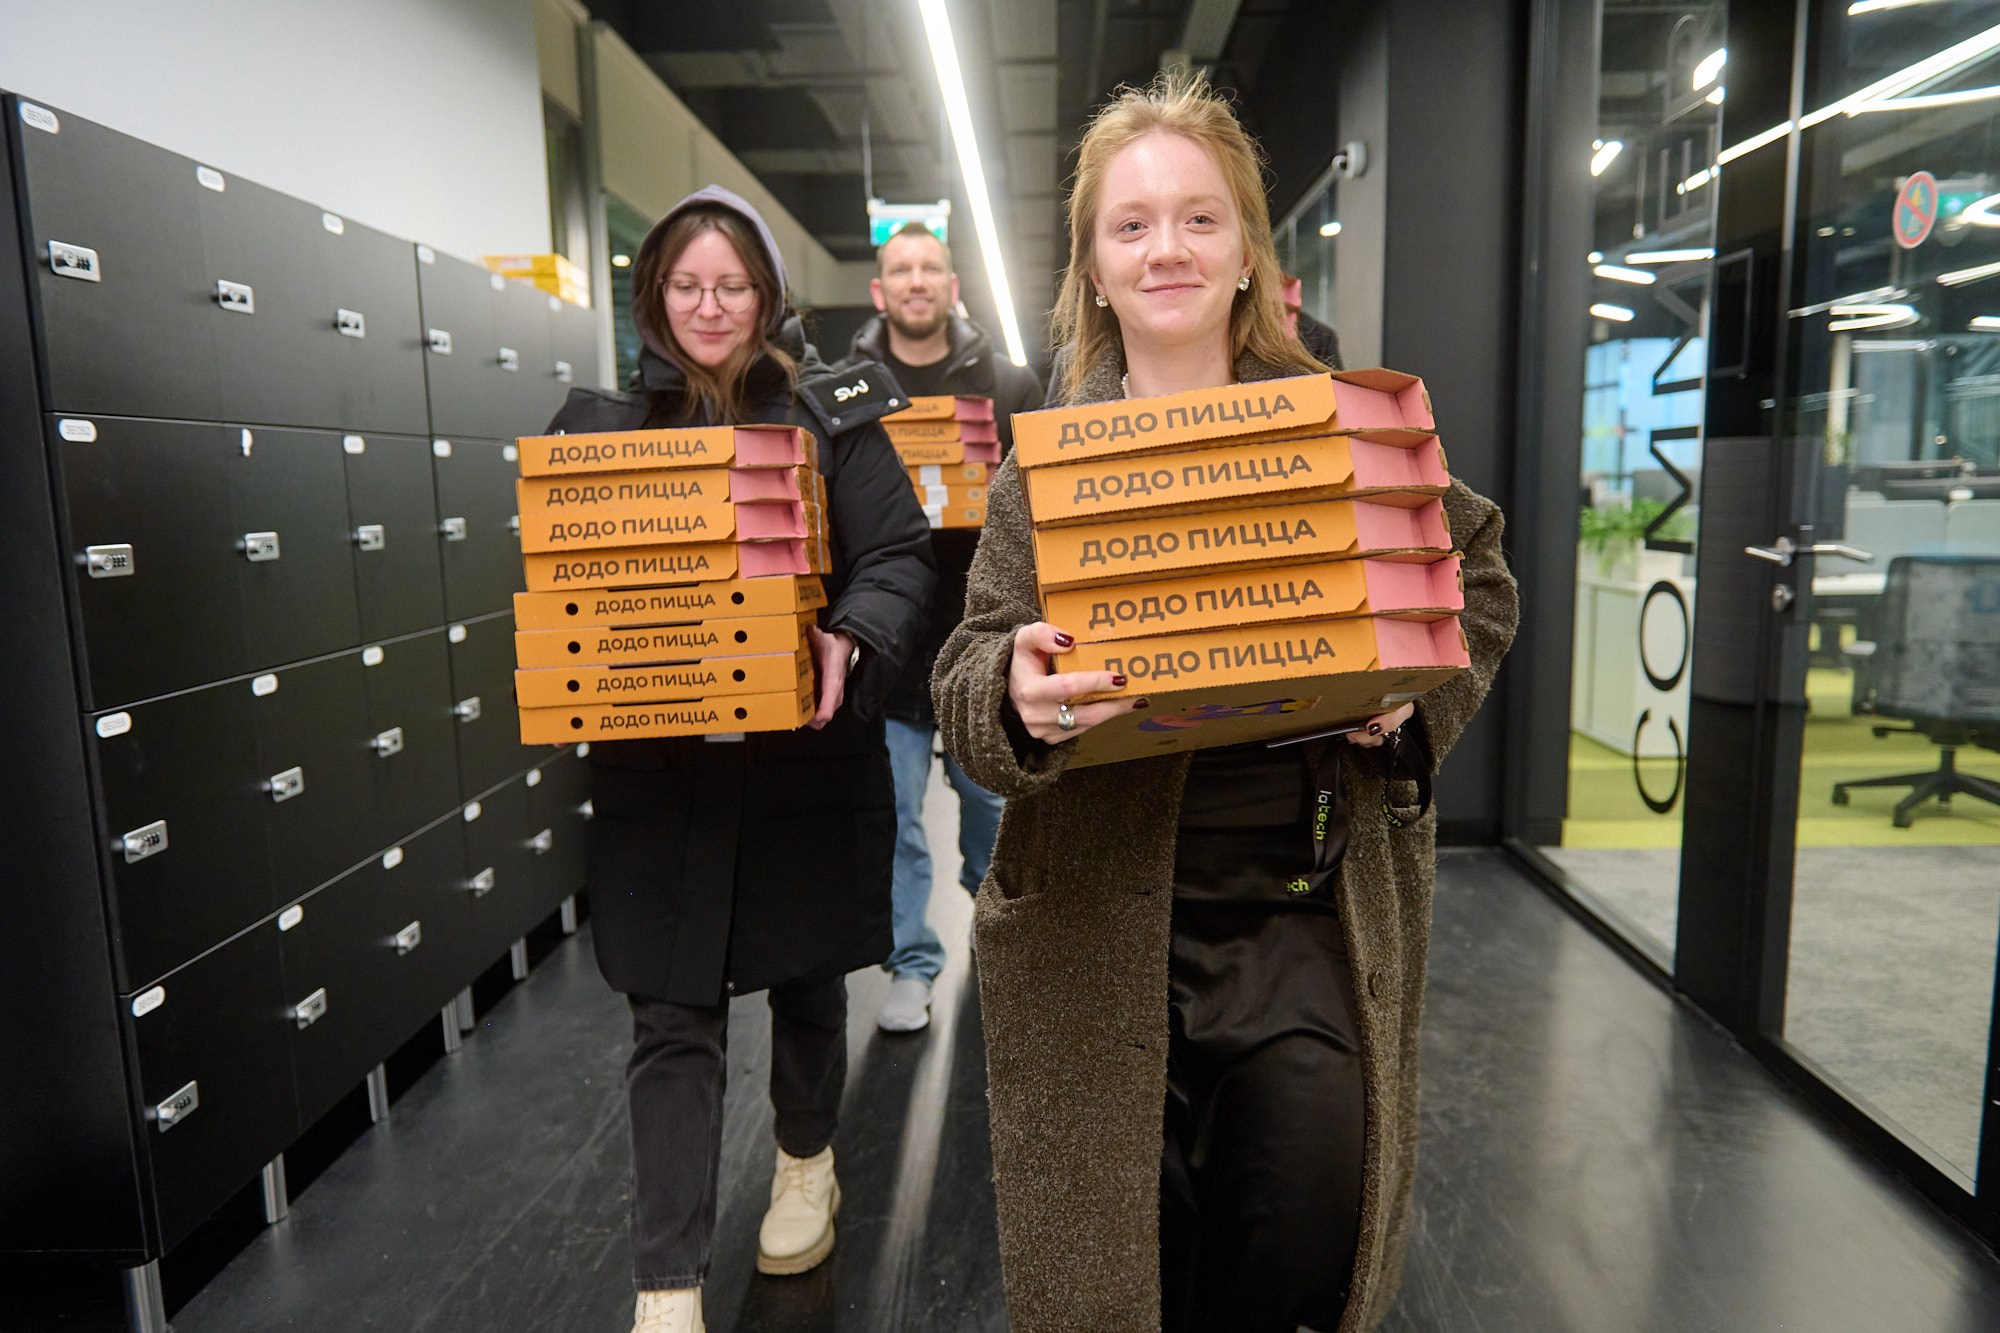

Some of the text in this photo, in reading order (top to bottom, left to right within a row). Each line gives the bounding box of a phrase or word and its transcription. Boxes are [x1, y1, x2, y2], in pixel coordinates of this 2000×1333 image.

[1058, 394, 1295, 449] ДОДО ПИЦЦА
[548, 440, 707, 466] ДОДО ПИЦЦА
[1073, 454, 1312, 504] ДОДО ПИЦЦА
[547, 482, 702, 506] ДОДО ПИЦЦА
[549, 516, 707, 542] ДОДО ПИЦЦА
[1080, 519, 1316, 567] ДОДО ПИЦЦА
[553, 554, 709, 582] ДОДО ПИЦЦА
[595, 594, 715, 615] ДОДО ПИЦЦА
[1088, 579, 1324, 629] ДОДО ПИЦЦА
[598, 633, 718, 653] ДОДО ПИЦЦА
[1209, 637, 1335, 670] ПИЦЦА
[597, 672, 717, 692] ДОДО ПИЦЦА
[600, 711, 719, 730] ДОДО ПИЦЦА
